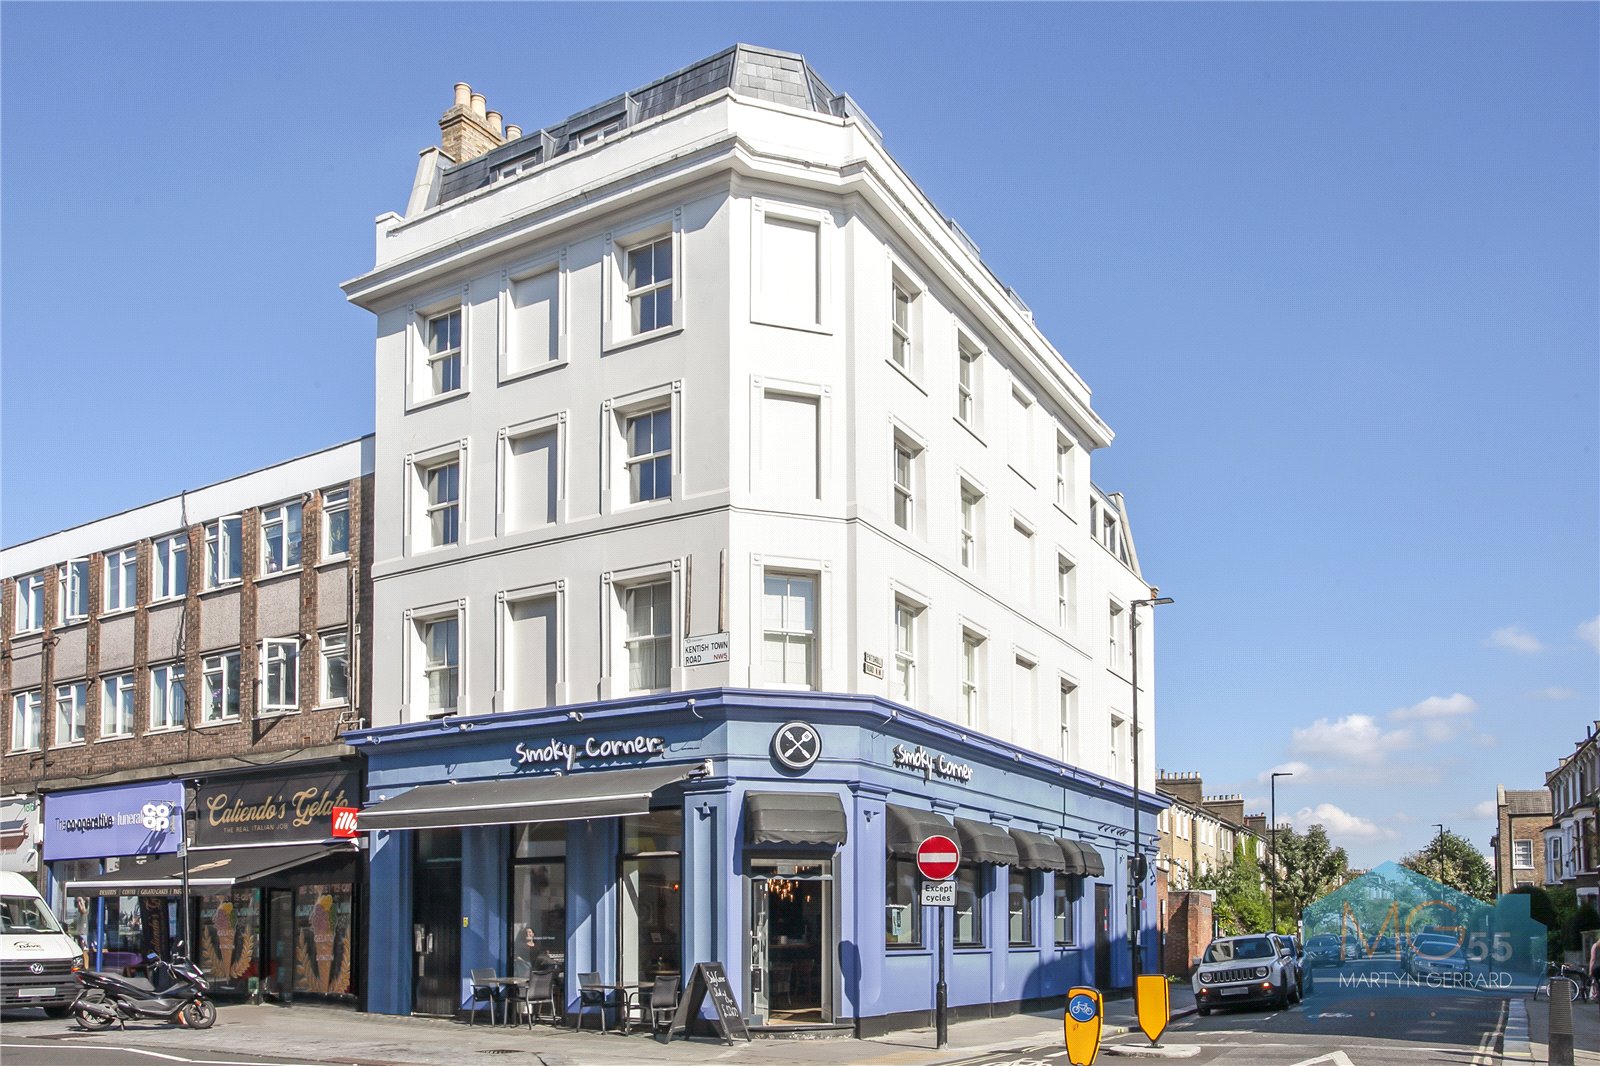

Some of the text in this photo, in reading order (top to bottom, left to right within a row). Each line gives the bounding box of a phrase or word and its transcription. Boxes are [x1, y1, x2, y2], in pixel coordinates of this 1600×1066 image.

[685, 641, 728, 654] KENTISH TOWN
[685, 655, 702, 665] ROAD
[514, 736, 661, 771] Smoky Corner
[895, 743, 973, 781] Smoky Corner
[206, 793, 286, 827] Caliendo's
[55, 818, 66, 831] The
[235, 825, 250, 833] REAL
[251, 824, 274, 832] ITALIAN
[276, 823, 289, 831] JOB
[334, 812, 358, 835] illy
[925, 884, 953, 895] Except
[925, 893, 951, 903] cycles
